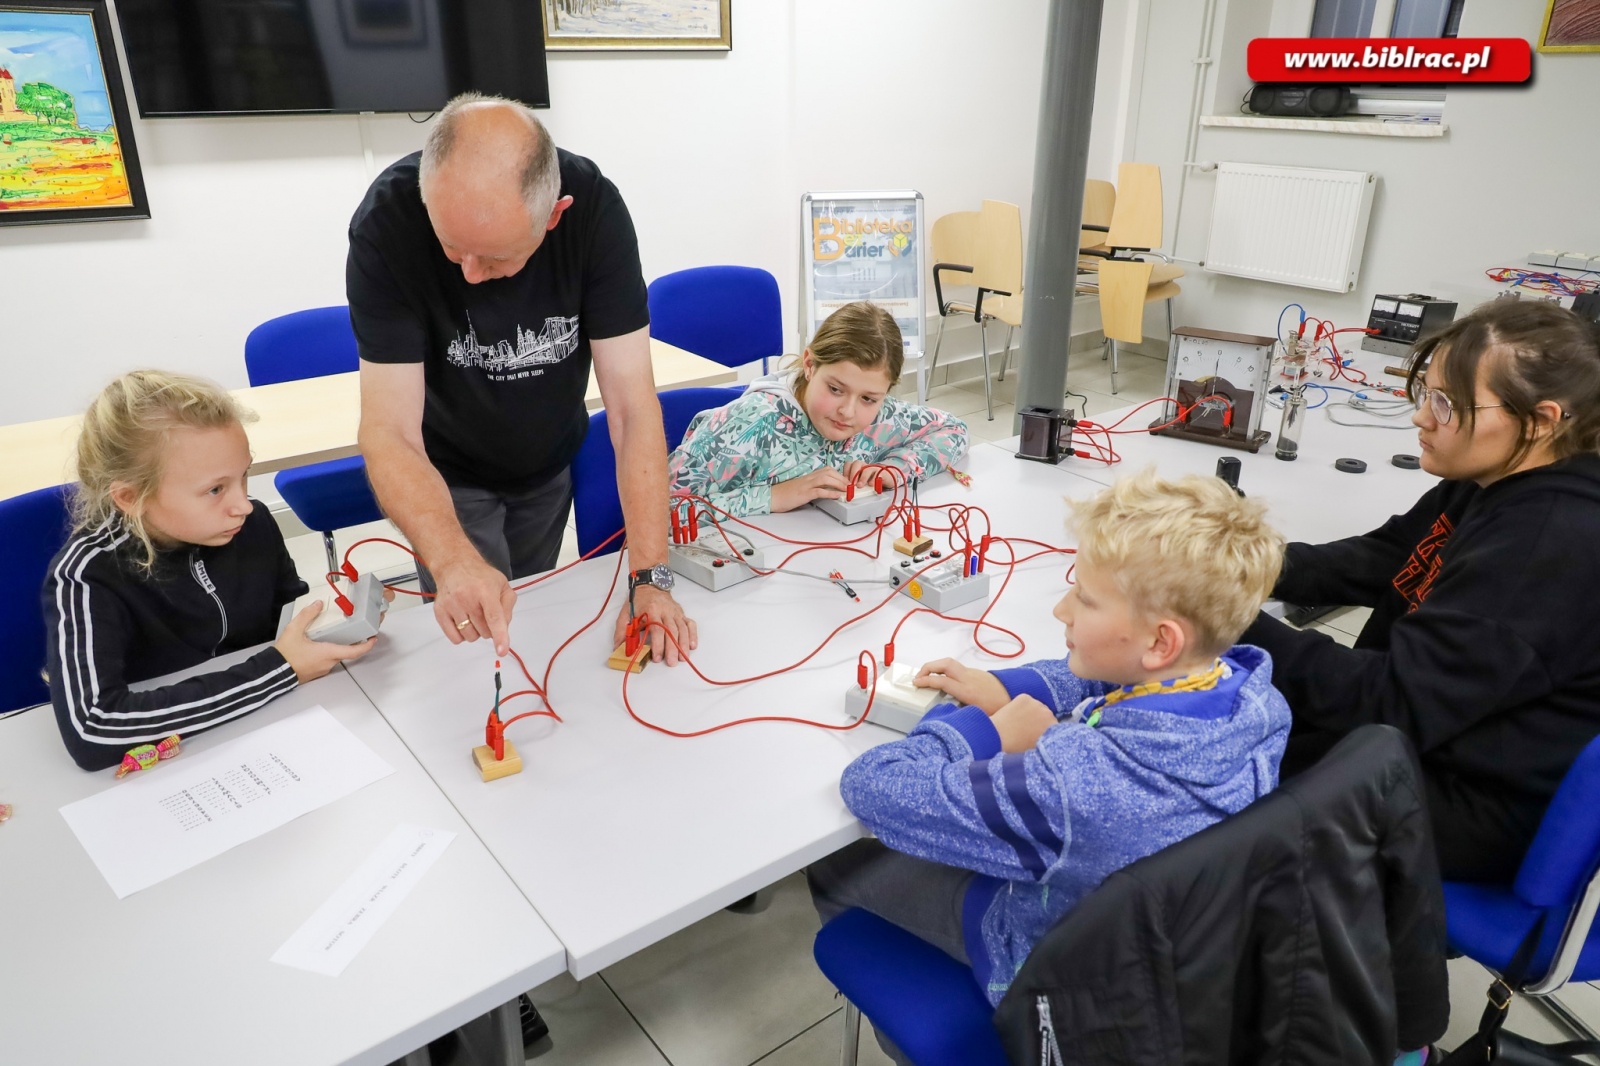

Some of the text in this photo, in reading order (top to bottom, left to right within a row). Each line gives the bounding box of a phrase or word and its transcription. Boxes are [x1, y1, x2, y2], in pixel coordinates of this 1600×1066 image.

[517, 371, 529, 379] NEVER
[530, 369, 544, 377] SLEEPS
[197, 561, 215, 590] SMILE
